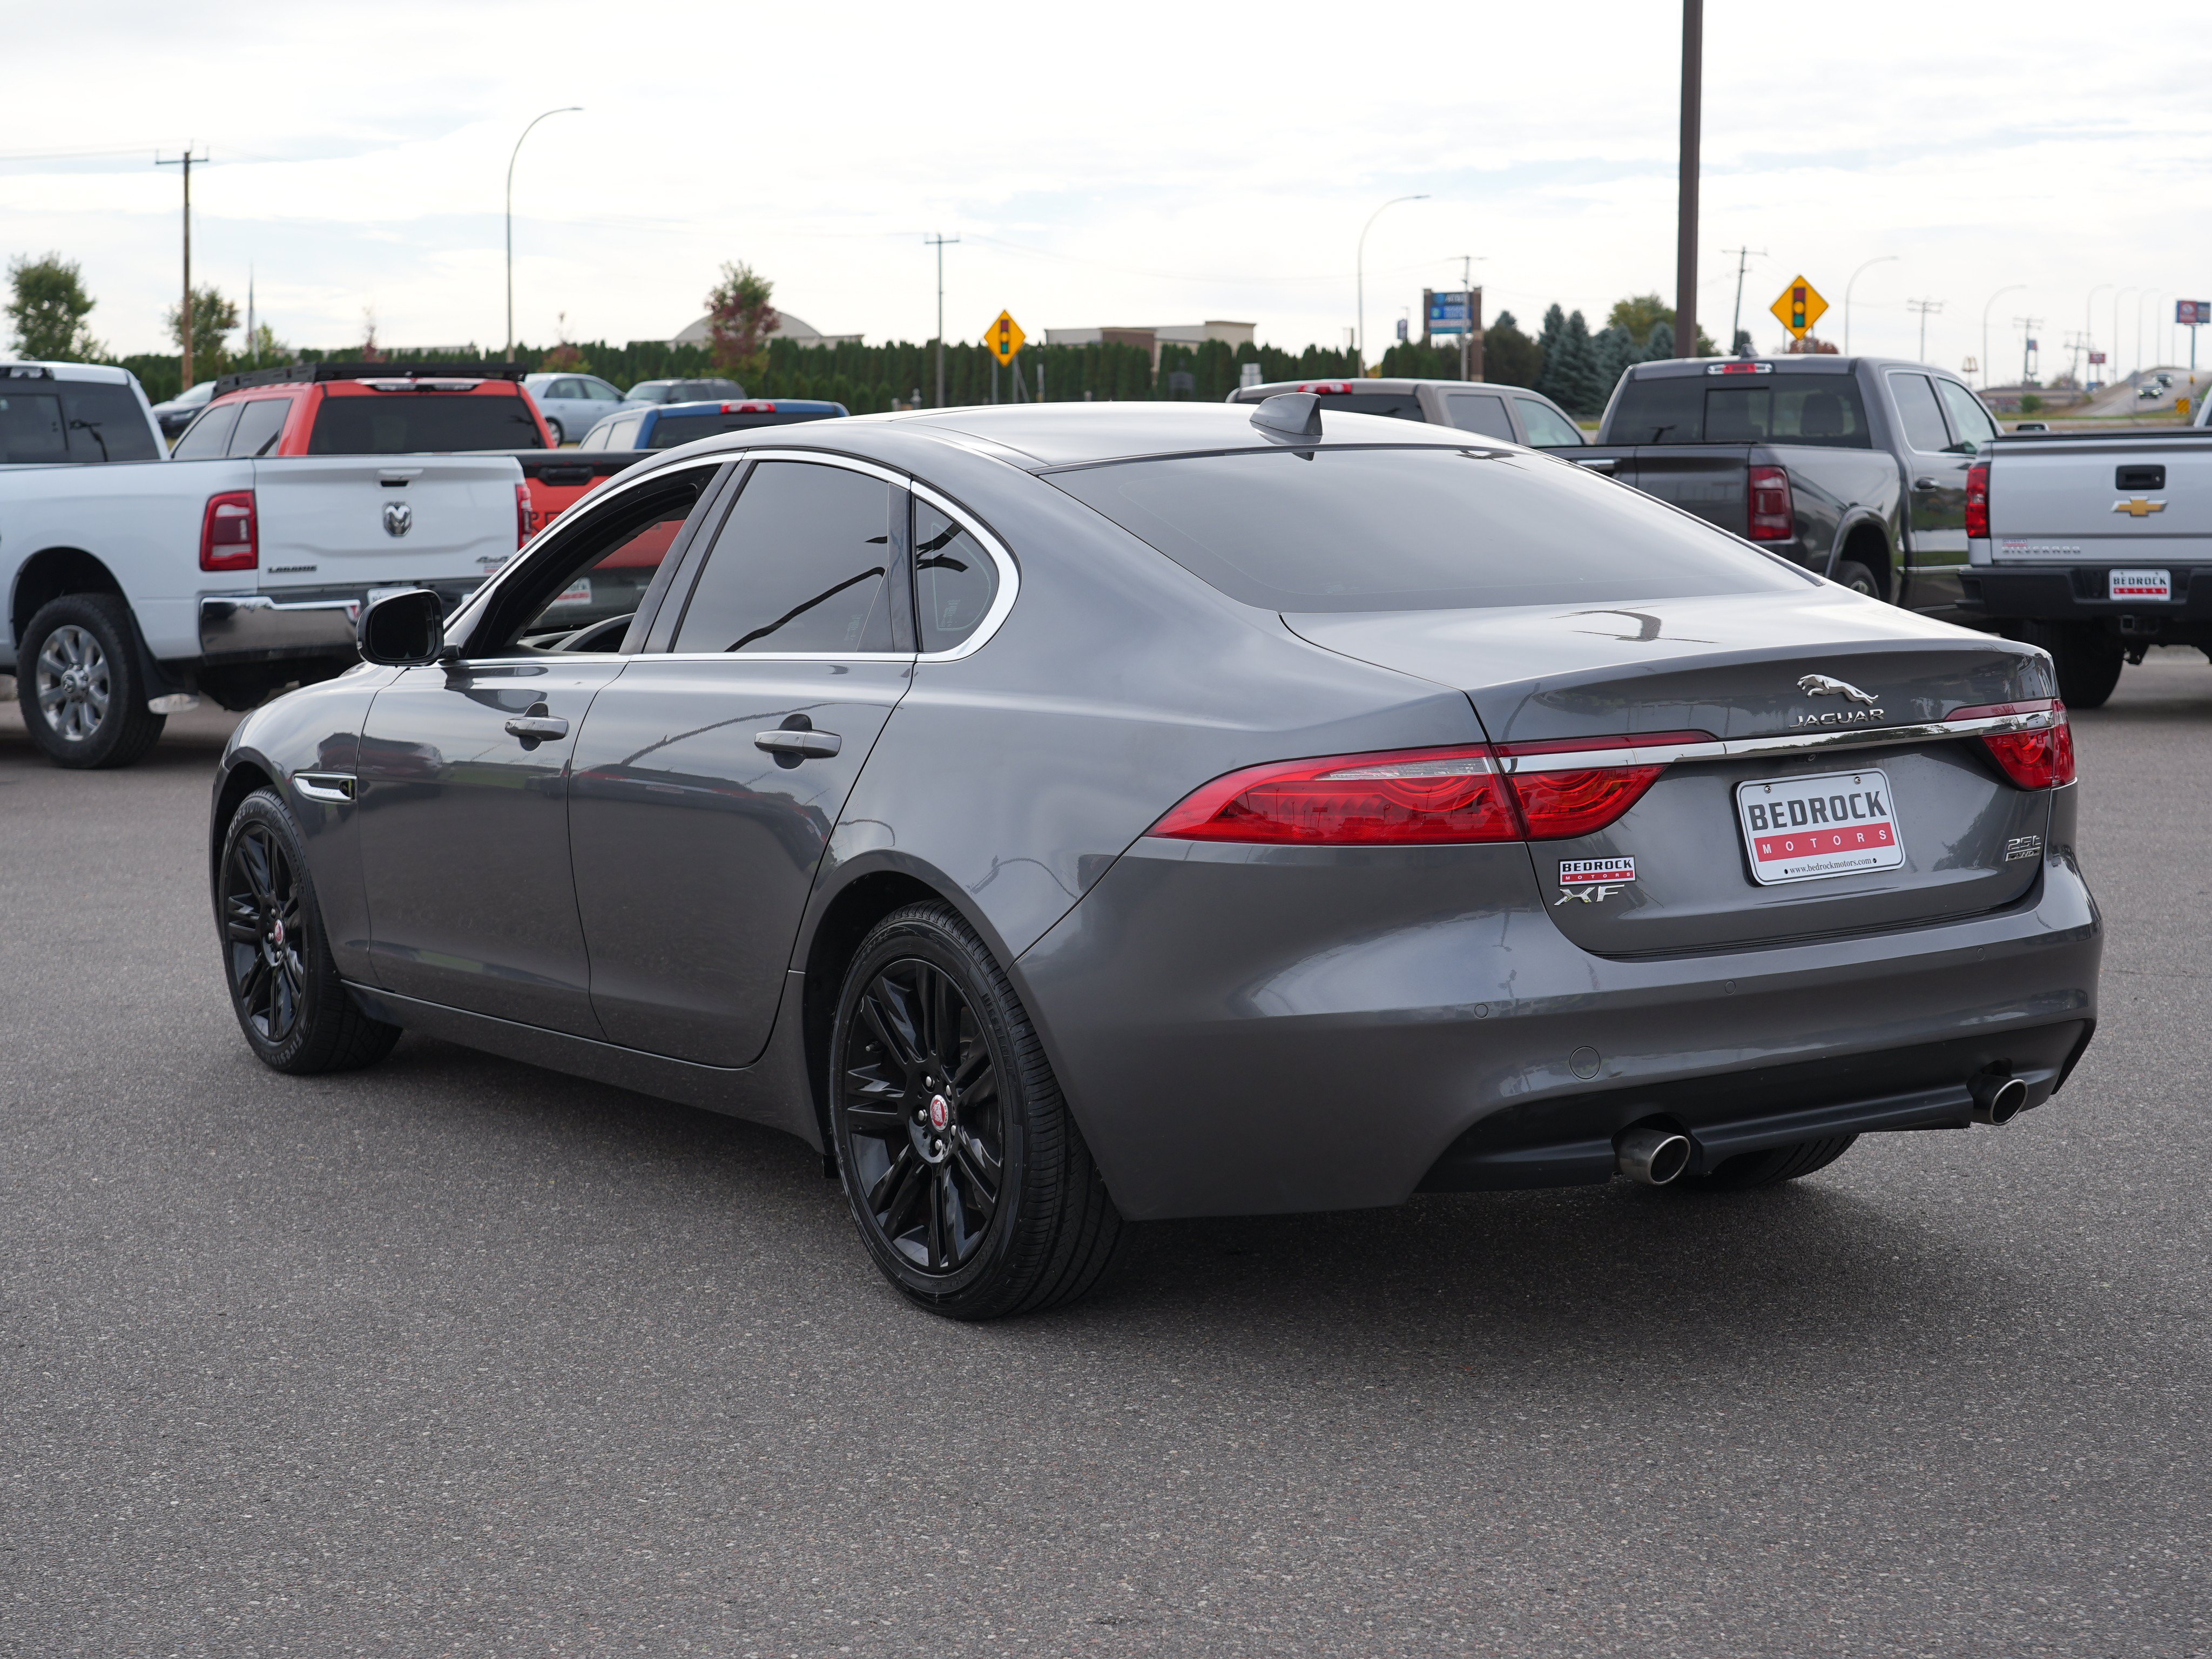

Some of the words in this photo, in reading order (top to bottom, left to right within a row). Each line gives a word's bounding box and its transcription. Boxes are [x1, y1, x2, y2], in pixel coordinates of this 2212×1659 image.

[2113, 577, 2167, 585] BEDROCK
[1789, 709, 1885, 729] JAGUAR
[1748, 791, 1887, 831] BEDROCK
[1762, 830, 1887, 854] MOTORS
[2008, 835, 2041, 851] 25t
[1562, 859, 1633, 872] BEDROCK
[1789, 858, 1872, 874] www.bedrockmotors.com
[1554, 884, 1625, 906] XF
